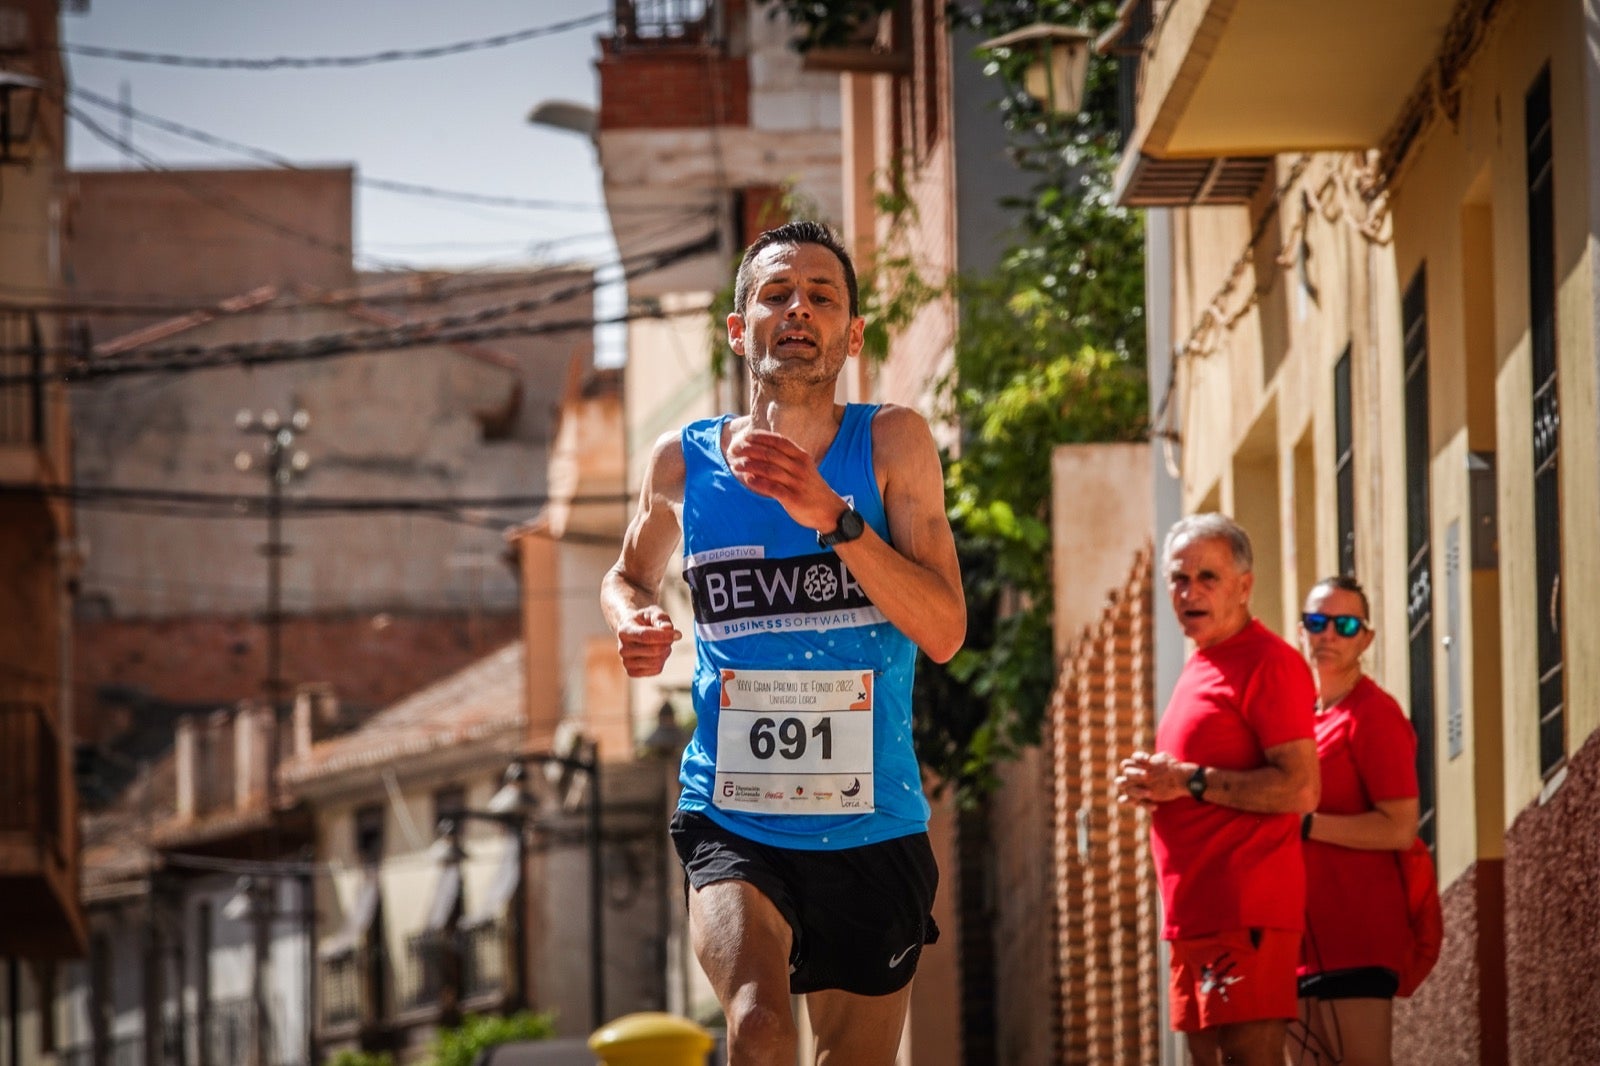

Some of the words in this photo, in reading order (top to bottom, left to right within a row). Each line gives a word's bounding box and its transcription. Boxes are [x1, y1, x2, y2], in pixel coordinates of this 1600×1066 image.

[709, 548, 757, 560] DEPORTIVO
[705, 562, 865, 613] BEWOR
[835, 680, 854, 693] 2022
[749, 717, 832, 760] 691
